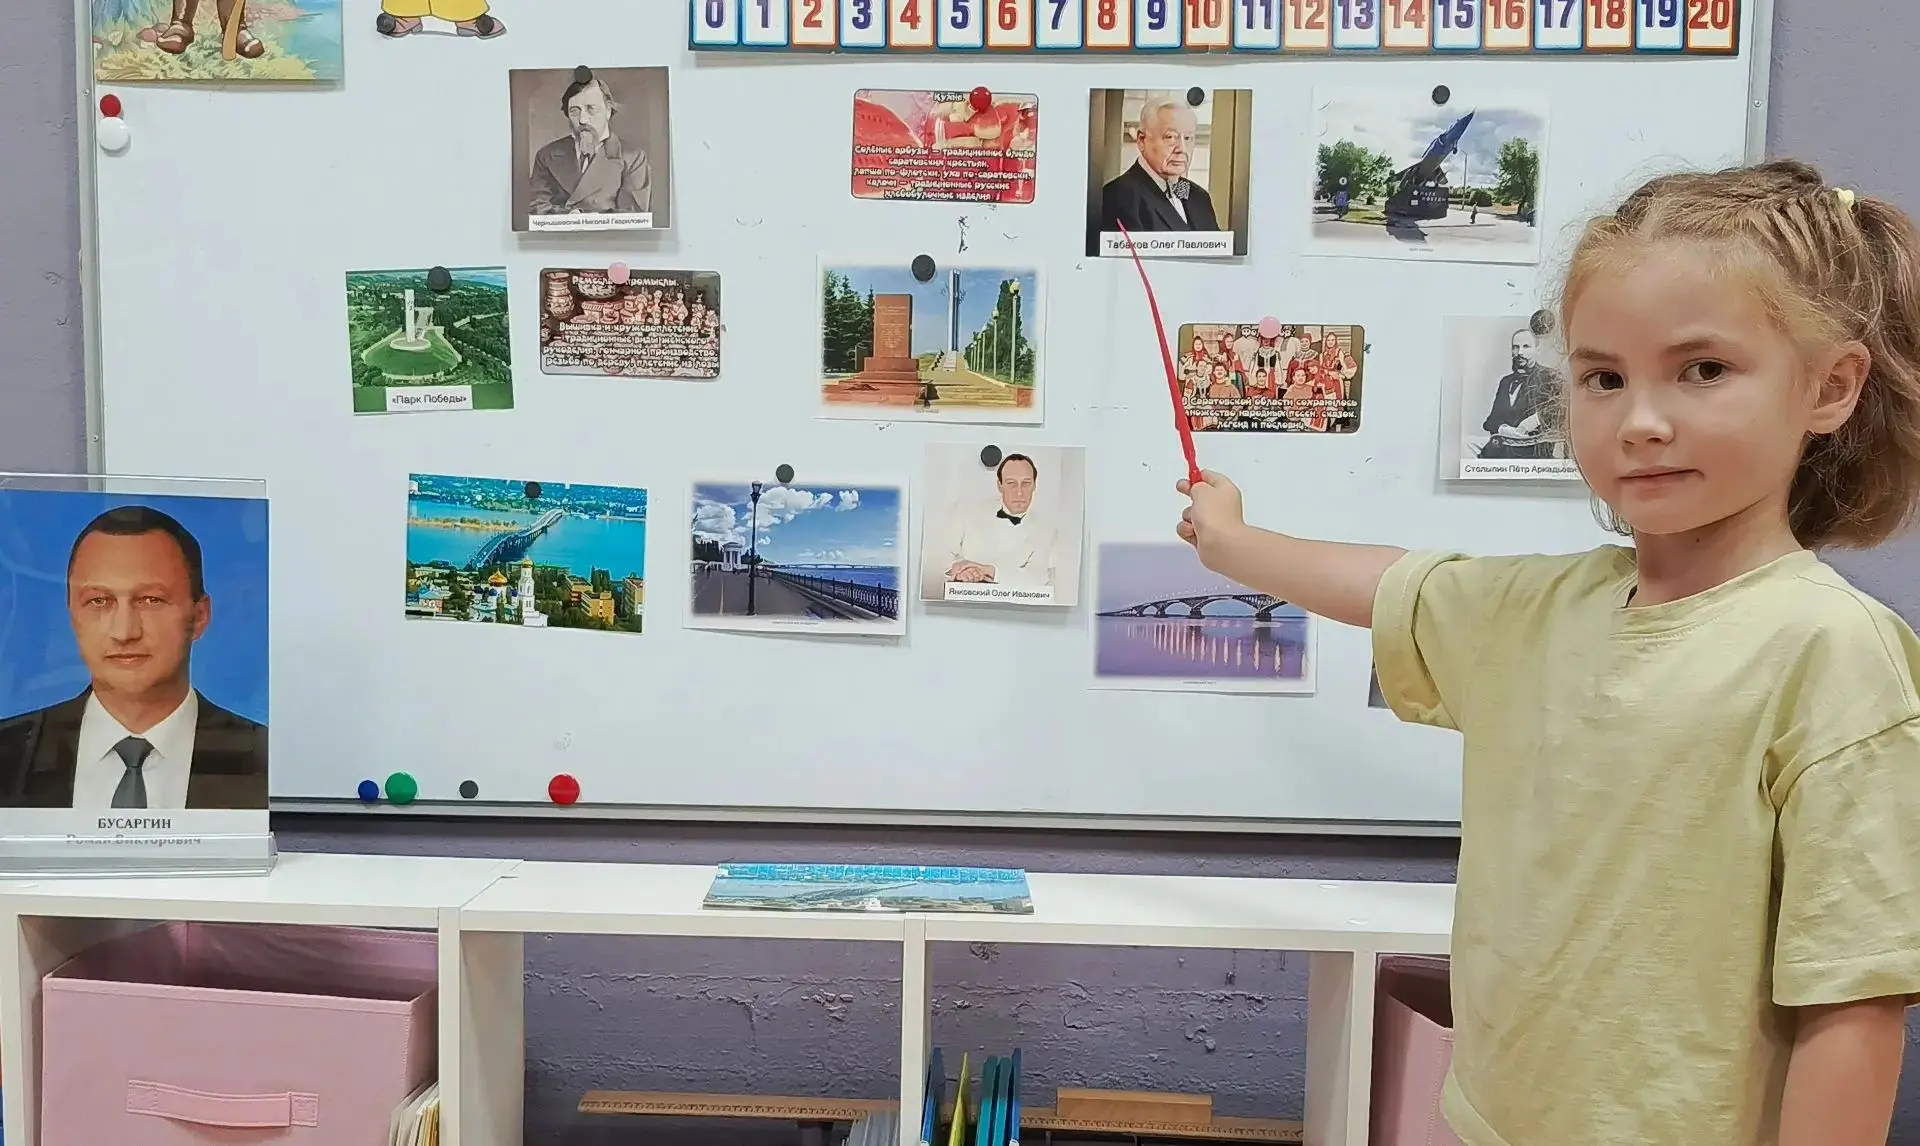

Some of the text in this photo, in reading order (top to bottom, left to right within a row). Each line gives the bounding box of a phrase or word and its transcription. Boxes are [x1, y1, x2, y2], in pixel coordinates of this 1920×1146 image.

[705, 0, 1730, 29] 0 1 2 3 4 5 6 7 8 9 10 11 12 13 14 15 16 17 18 19 20
[895, 146, 929, 156] арбузы
[943, 148, 1004, 158] традиционное
[1006, 149, 1035, 159] блюдо
[888, 159, 944, 167] саратовских
[943, 171, 960, 179] уха
[866, 178, 897, 187] калачи
[911, 180, 972, 189] традиционные
[975, 182, 1010, 190] русские
[884, 189, 954, 199] хлебобулочные
[1150, 239, 1174, 249] Олег
[1177, 239, 1227, 249] Павлович
[559, 322, 602, 332] Вышивка
[614, 324, 699, 334] кружевоплетение
[565, 335, 632, 344] традиционные
[635, 336, 659, 344] виды
[662, 336, 706, 345] женского
[599, 347, 647, 356] гончарное
[547, 356, 580, 366] резьба
[583, 358, 595, 366] по
[637, 359, 679, 368] плетение
[695, 360, 719, 369] лозы
[392, 394, 467, 405] «Парк Победы»
[1190, 397, 1251, 405] Саратовской
[1255, 397, 1293, 406] области
[1296, 399, 1358, 407] сохранилось
[1239, 409, 1286, 418] народных
[1216, 420, 1249, 430] легенд
[1464, 464, 1508, 473] Столыпин
[1508, 464, 1530, 474] Пётр
[949, 588, 1051, 599] Янковский Олег Иванович
[97, 818, 172, 829] БУСАРГИН
